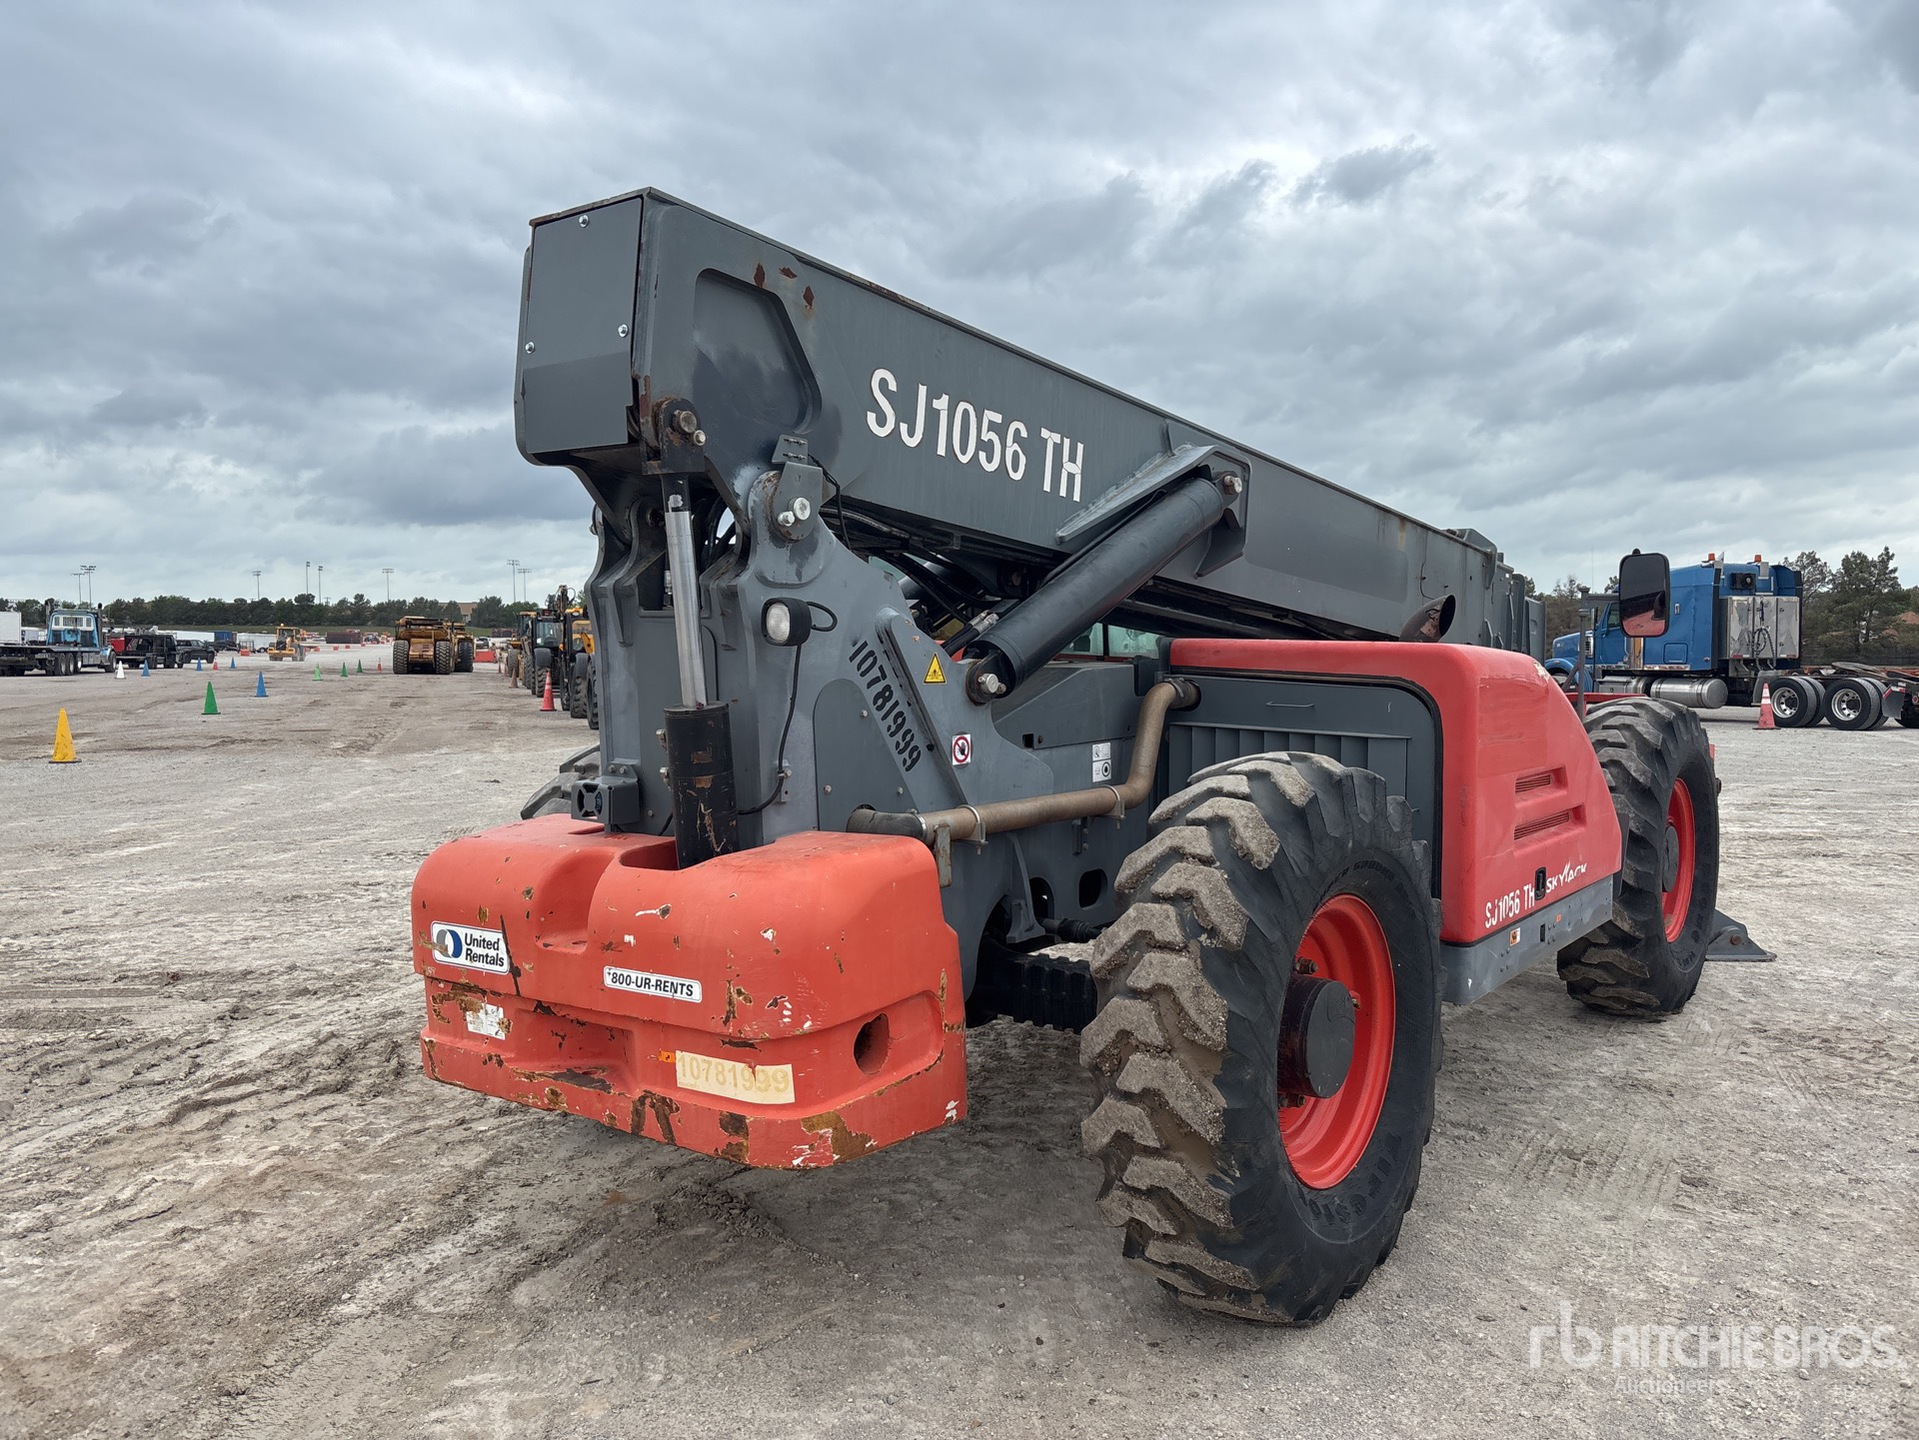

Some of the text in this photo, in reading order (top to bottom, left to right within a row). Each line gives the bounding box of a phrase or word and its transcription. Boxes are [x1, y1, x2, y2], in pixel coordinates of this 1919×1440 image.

[866, 368, 1084, 502] SJ1056 TH
[848, 640, 922, 773] 10781999
[1485, 883, 1535, 928] SJ1056 TH
[464, 932, 500, 951] United
[465, 949, 505, 967] Rentals
[610, 971, 694, 997] 800-UR-RENTS
[677, 1053, 789, 1093] 10781999
